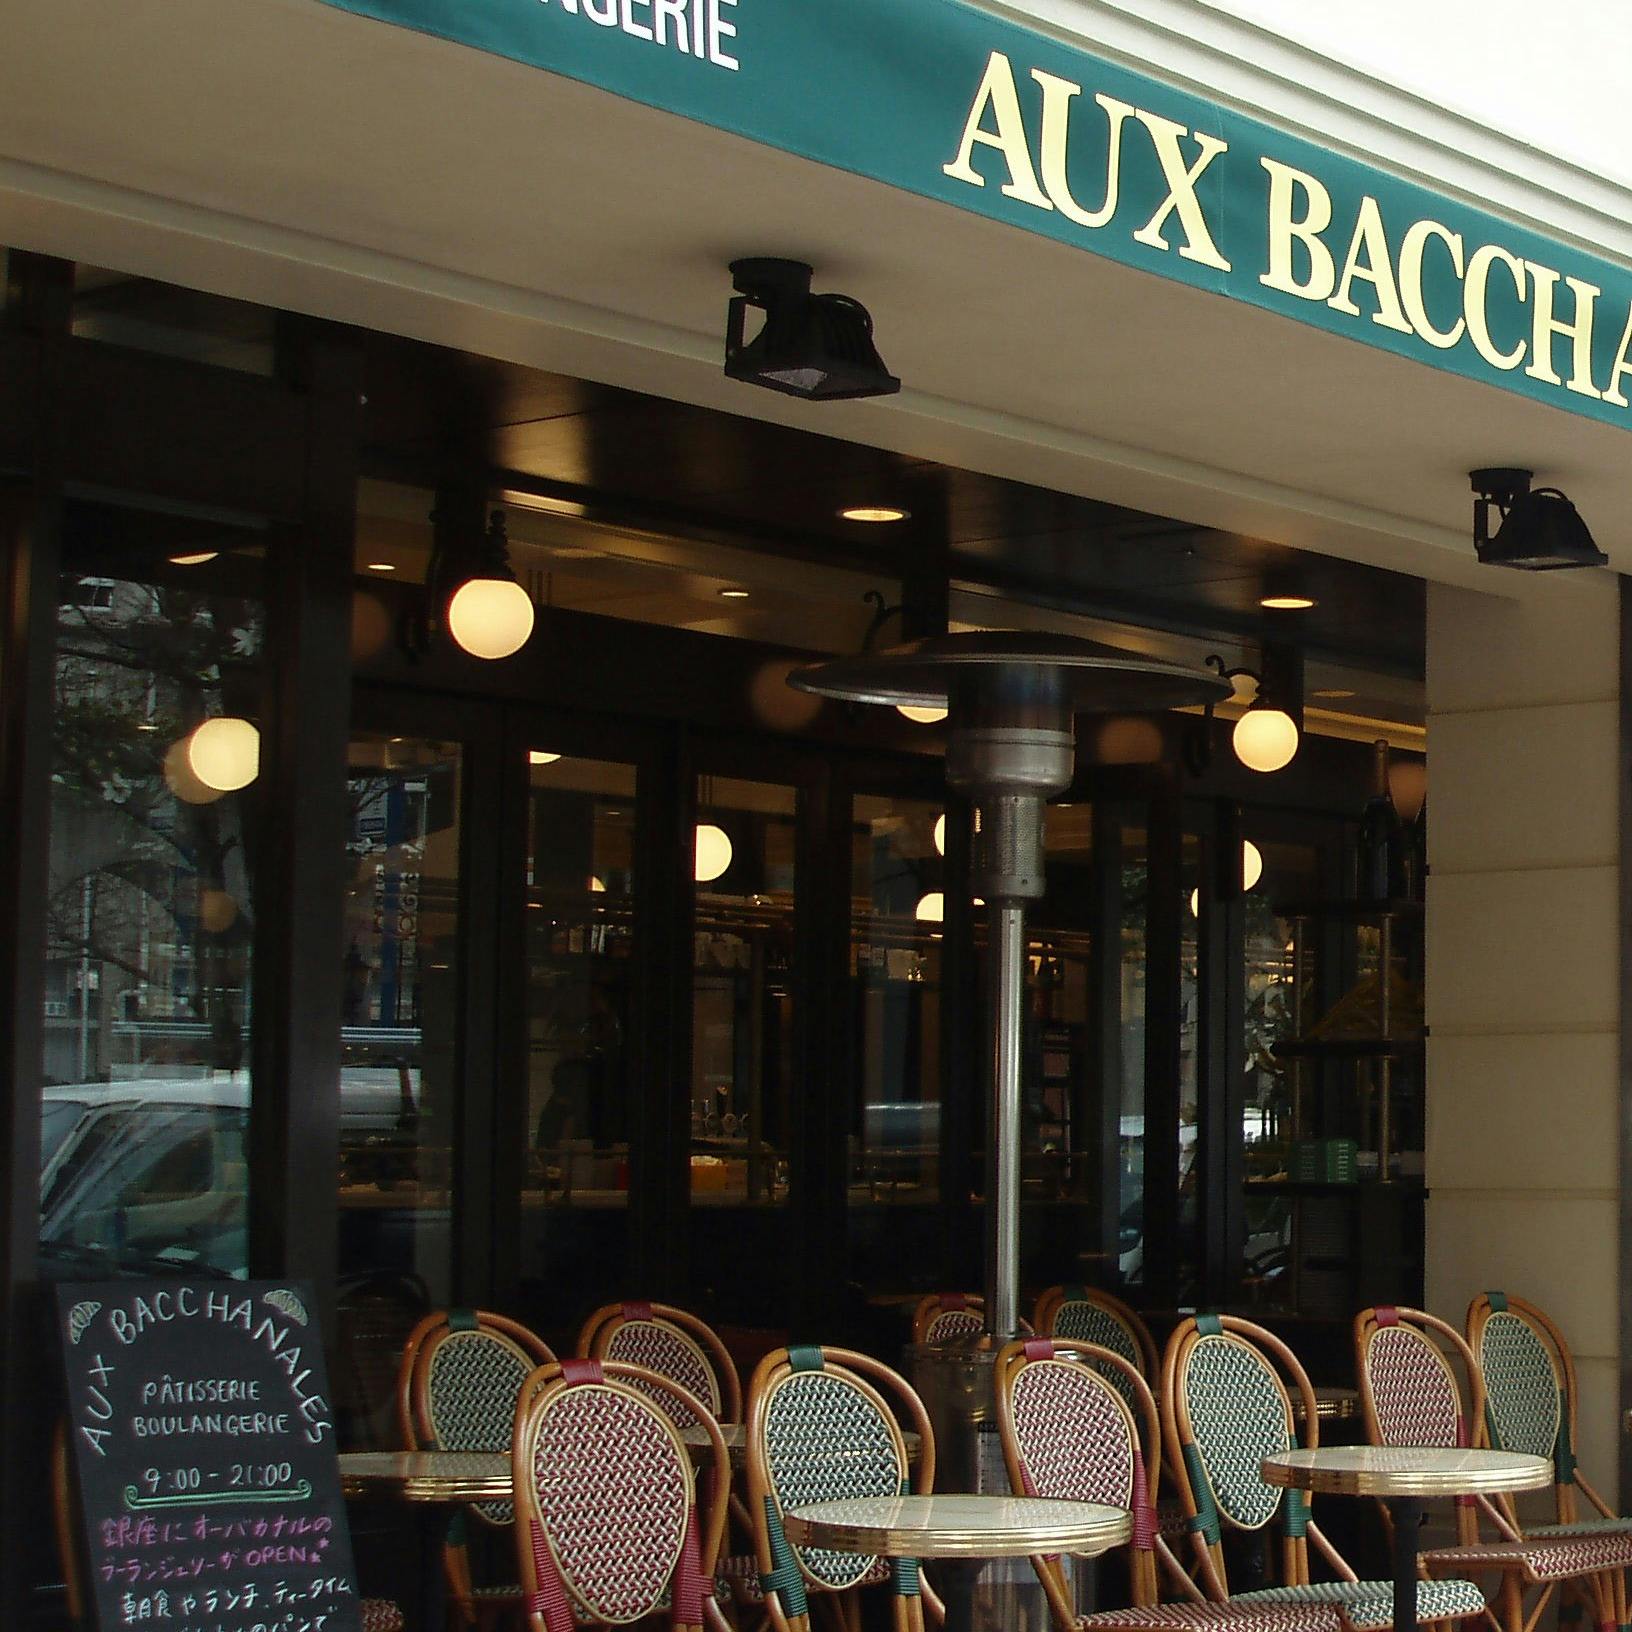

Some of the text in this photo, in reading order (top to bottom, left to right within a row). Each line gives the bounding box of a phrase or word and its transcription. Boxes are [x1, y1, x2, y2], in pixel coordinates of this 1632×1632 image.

[943, 50, 1232, 273] AUX
[81, 1287, 332, 1456] AUX BACCHANALES
[143, 1374, 261, 1405] PÂTISSERIE
[134, 1411, 290, 1437] BOULANGERIE
[144, 1467, 201, 1493] 9:00
[230, 1462, 292, 1488] 21:00
[246, 1545, 306, 1567] OPEN
